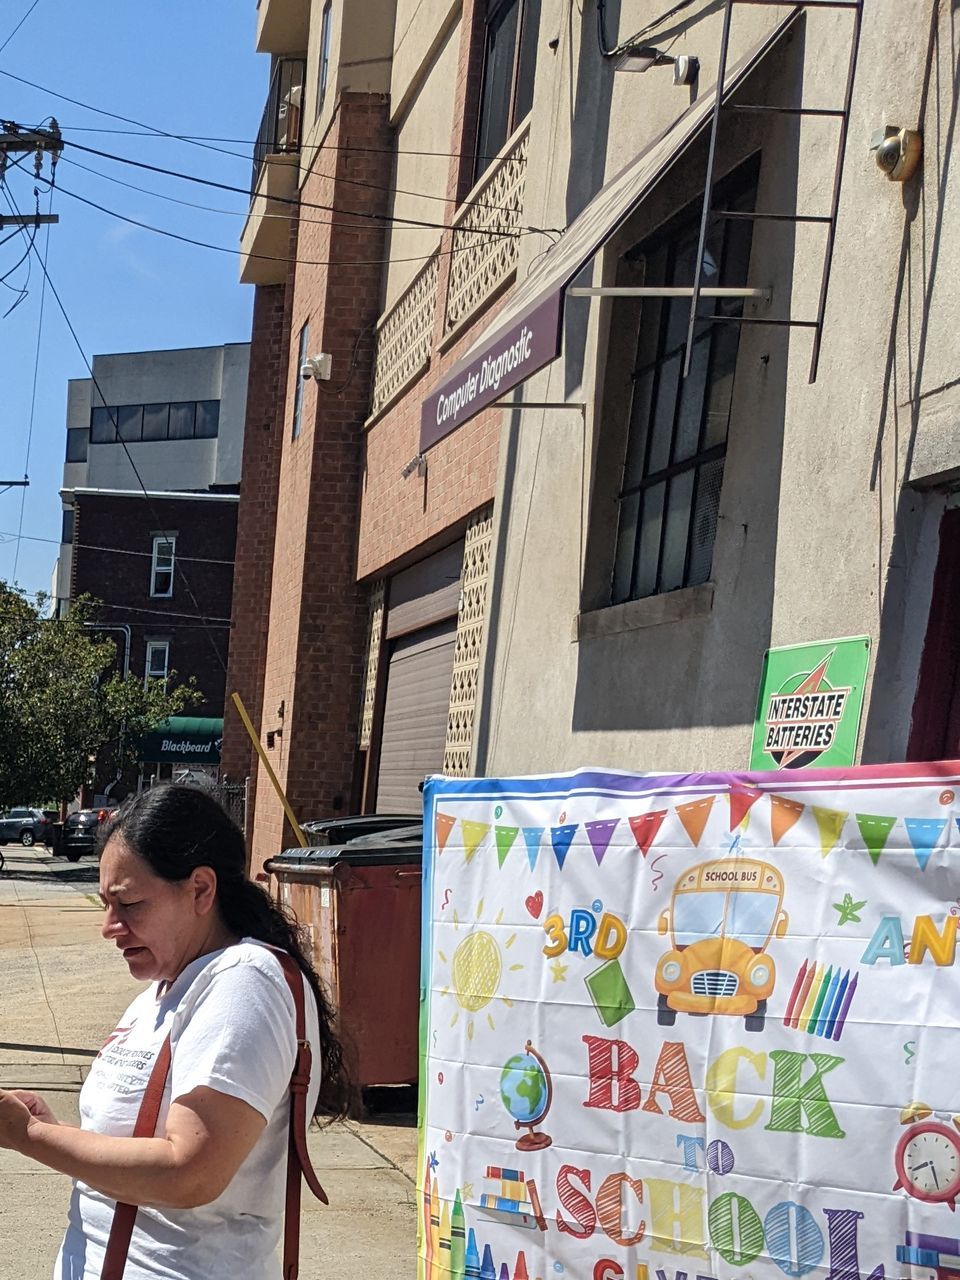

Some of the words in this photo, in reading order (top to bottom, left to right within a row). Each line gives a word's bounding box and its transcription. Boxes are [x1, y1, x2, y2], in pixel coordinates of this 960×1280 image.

[436, 372, 480, 426] Computer
[479, 326, 533, 394] Diagnostic
[768, 693, 845, 721] INTERSTATE
[160, 740, 212, 754] Blackbeard
[765, 723, 834, 748] BATTERIES
[705, 871, 739, 882] SCHOOL
[741, 871, 757, 882] BUS
[542, 908, 628, 960] 3RD
[859, 914, 959, 967] AN
[582, 1034, 846, 1139] BACK
[676, 1133, 735, 1176] TO
